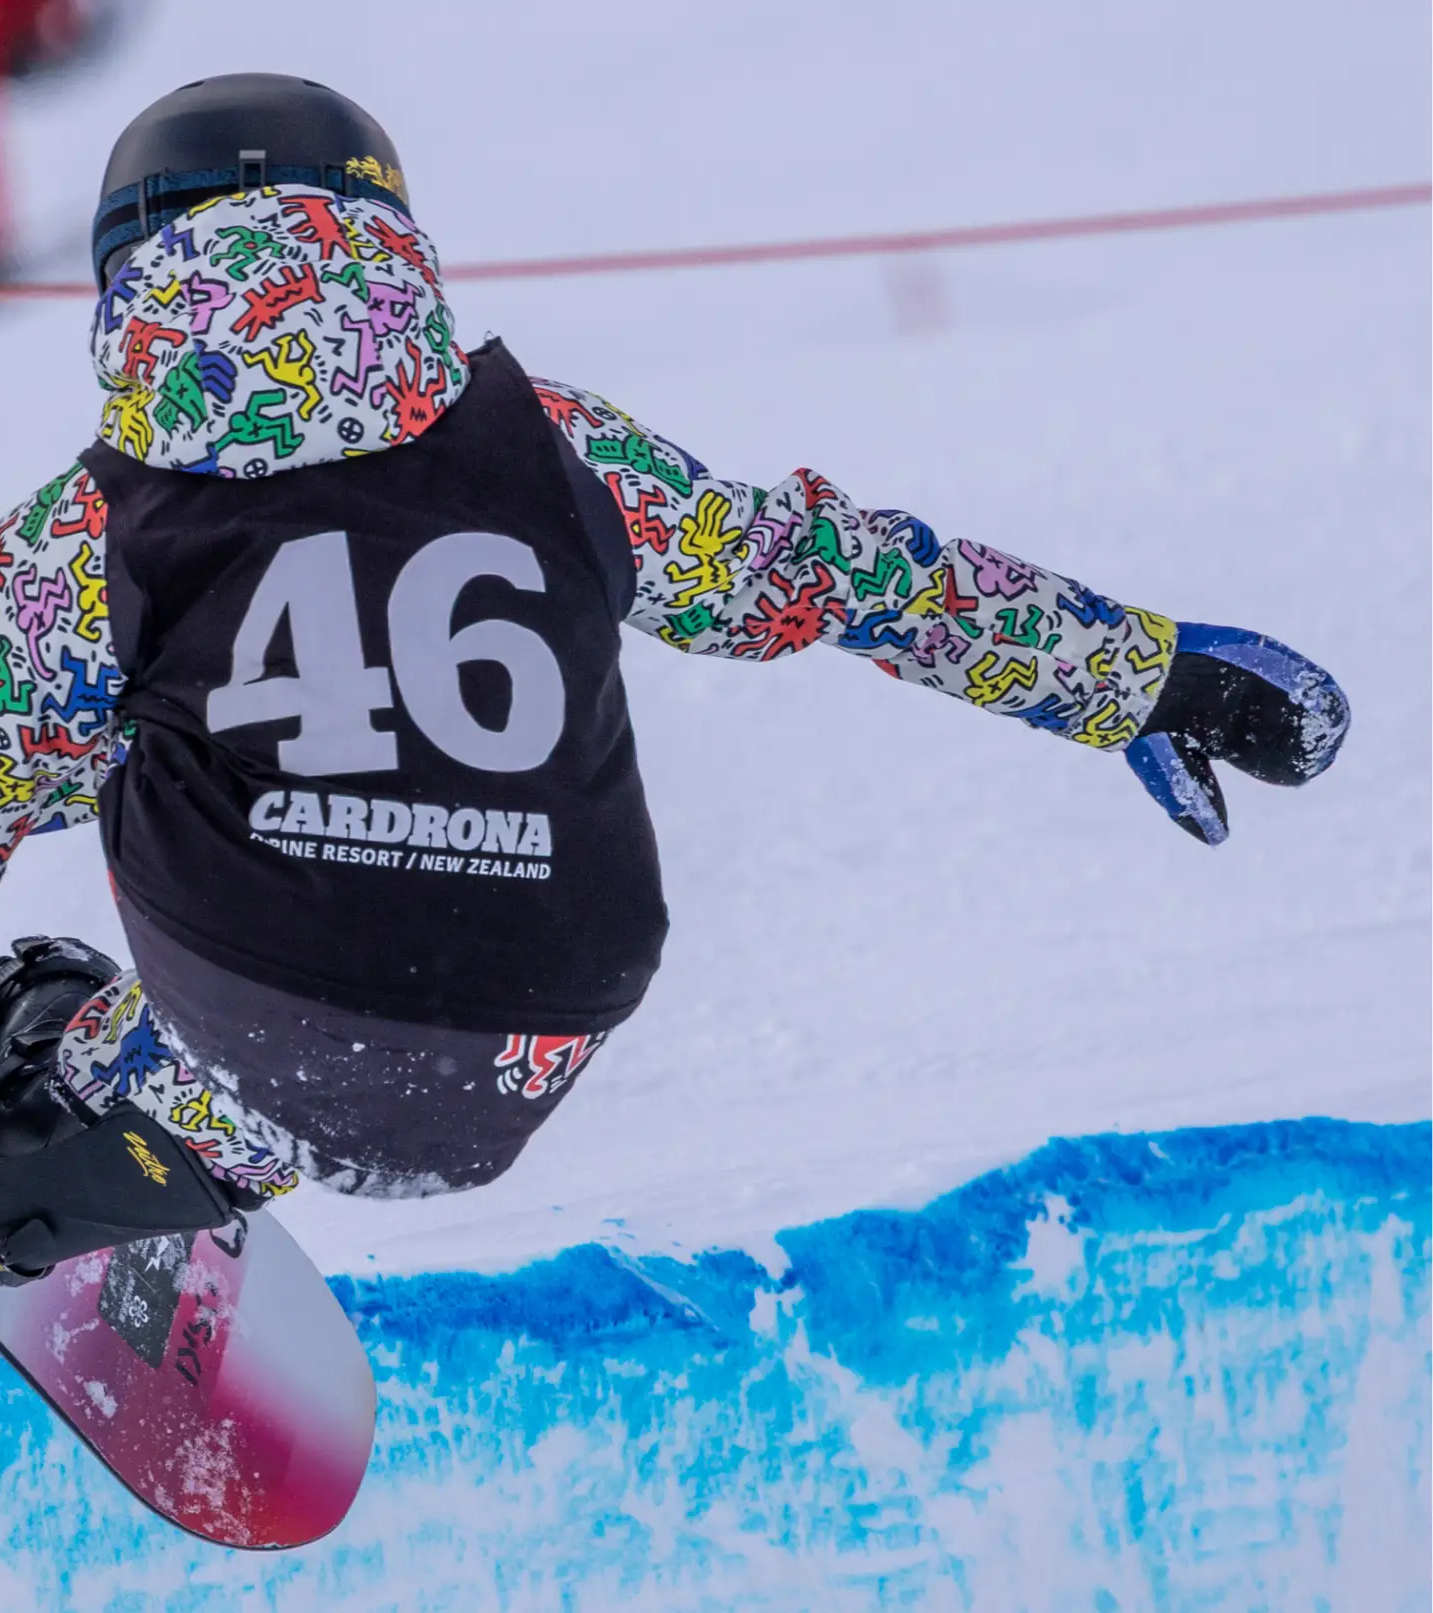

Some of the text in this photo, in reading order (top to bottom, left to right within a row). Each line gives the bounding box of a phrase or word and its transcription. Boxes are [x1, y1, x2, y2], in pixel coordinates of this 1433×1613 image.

[206, 530, 566, 777] 46
[248, 790, 553, 857] CARDRONA
[250, 832, 318, 859] PINE
[321, 843, 405, 869] RESORT
[420, 853, 465, 874] NEW
[466, 858, 552, 880] ZEALAND
